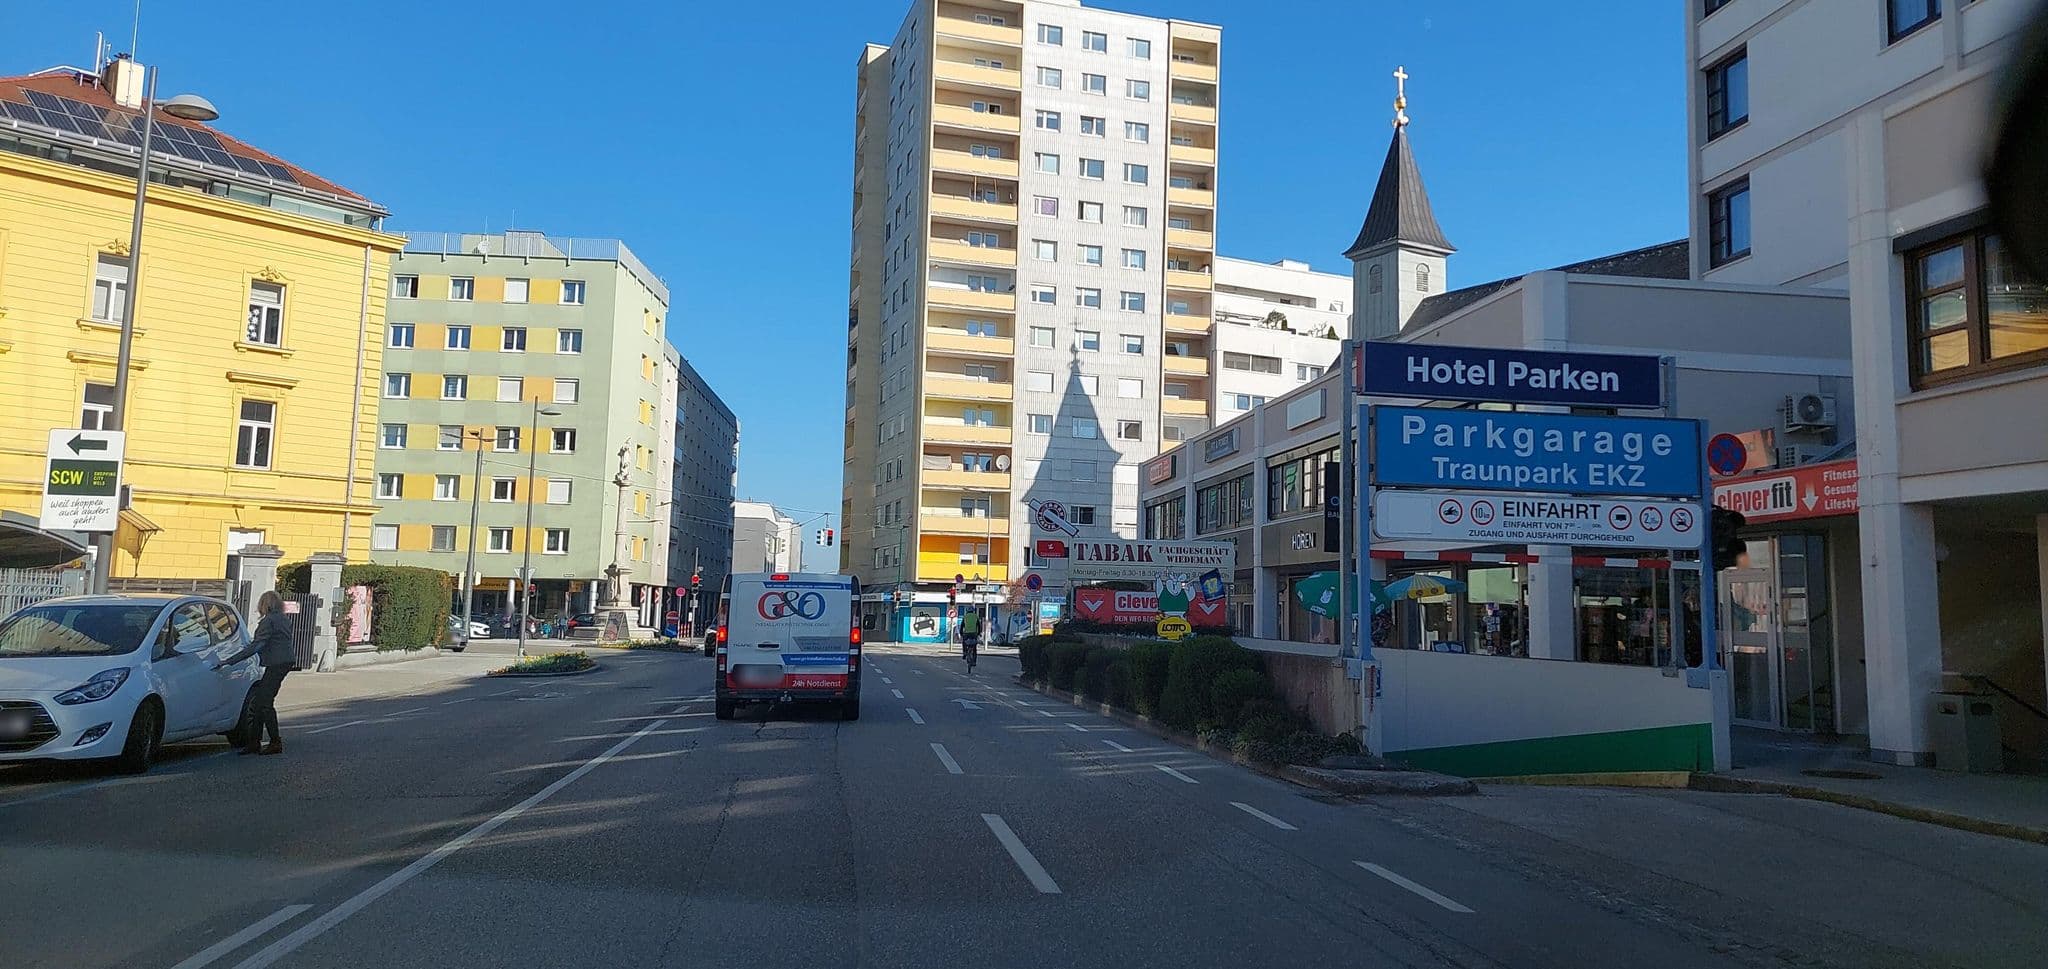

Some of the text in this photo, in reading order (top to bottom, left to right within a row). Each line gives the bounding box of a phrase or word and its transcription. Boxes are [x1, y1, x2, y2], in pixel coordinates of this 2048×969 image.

[1407, 356, 1620, 393] Hotel Parken
[1402, 415, 1673, 462] Parkgarage
[50, 471, 84, 485] SCW
[1431, 456, 1646, 487] Traunpark EKZ
[1823, 468, 1858, 483] Fitness
[71, 498, 104, 508] shoppen
[59, 506, 111, 516] auch anders
[1503, 501, 1602, 520] EINFAHRT
[1503, 521, 1544, 529] EINFAHRT
[1545, 522, 1562, 530] VON
[1468, 529, 1504, 538] ZUGANG
[1526, 532, 1569, 540] AUSFAHRT
[1571, 533, 1635, 542] DURCHGEHEND
[1073, 543, 1154, 563] TABAK
[1158, 545, 1231, 556] FACHGESCHÄFT
[1166, 555, 1222, 565] WIEDEMANN
[1117, 595, 1158, 609] cleve
[1162, 624, 1187, 632] LOTTO
[806, 680, 842, 688] Notdienst
